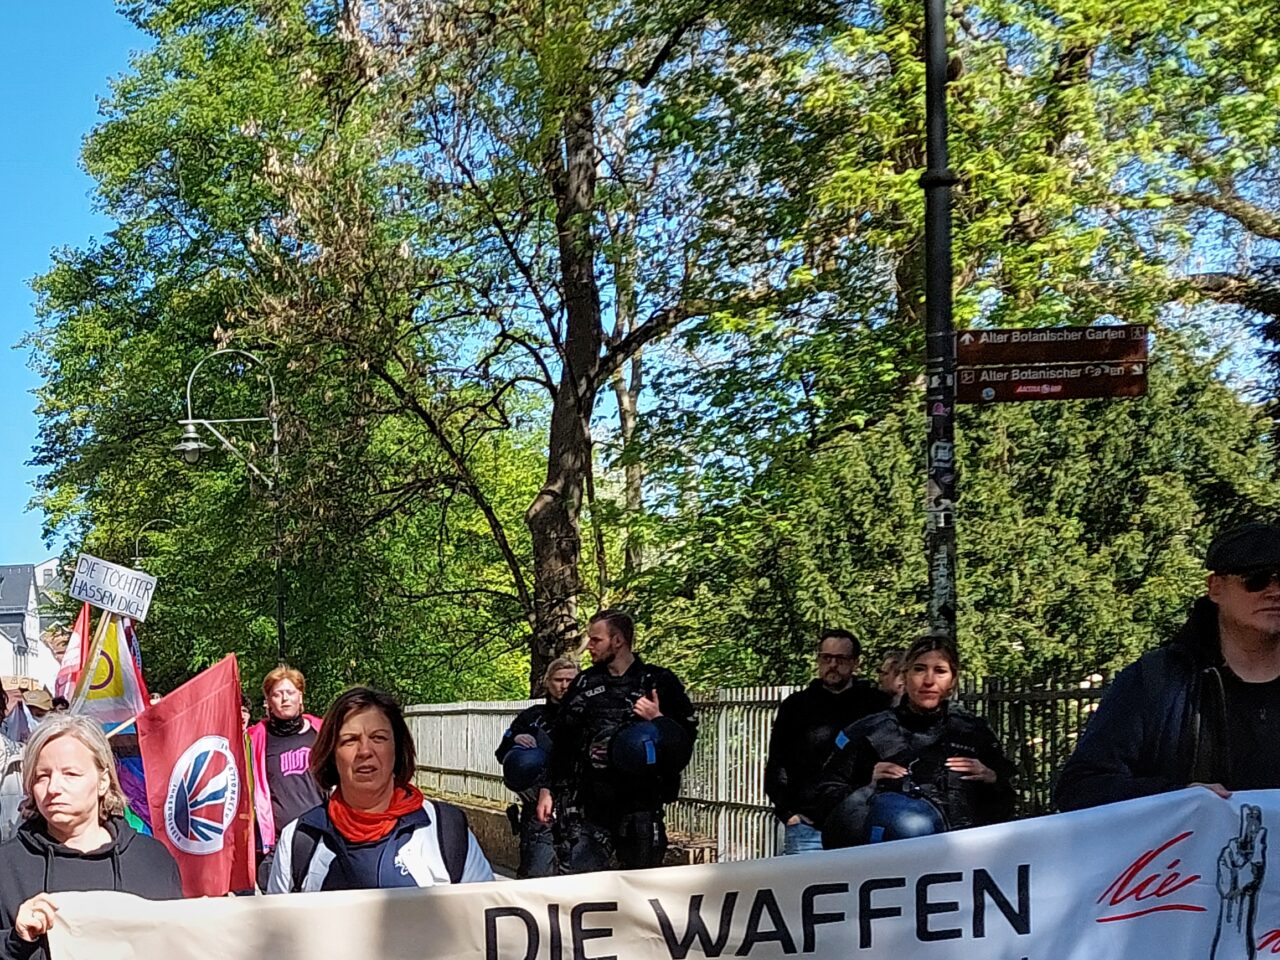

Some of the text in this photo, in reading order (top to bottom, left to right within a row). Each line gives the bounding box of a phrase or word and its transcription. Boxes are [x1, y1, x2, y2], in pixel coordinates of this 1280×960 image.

[979, 327, 1126, 344] Alter Botanischer Garten
[979, 369, 1009, 381] Alter
[1010, 366, 1082, 380] Botanischer
[77, 558, 100, 579] DIE
[72, 577, 145, 617] HASSEN DICH
[1096, 830, 1203, 907] Nie
[648, 863, 1032, 960] WAFFEN
